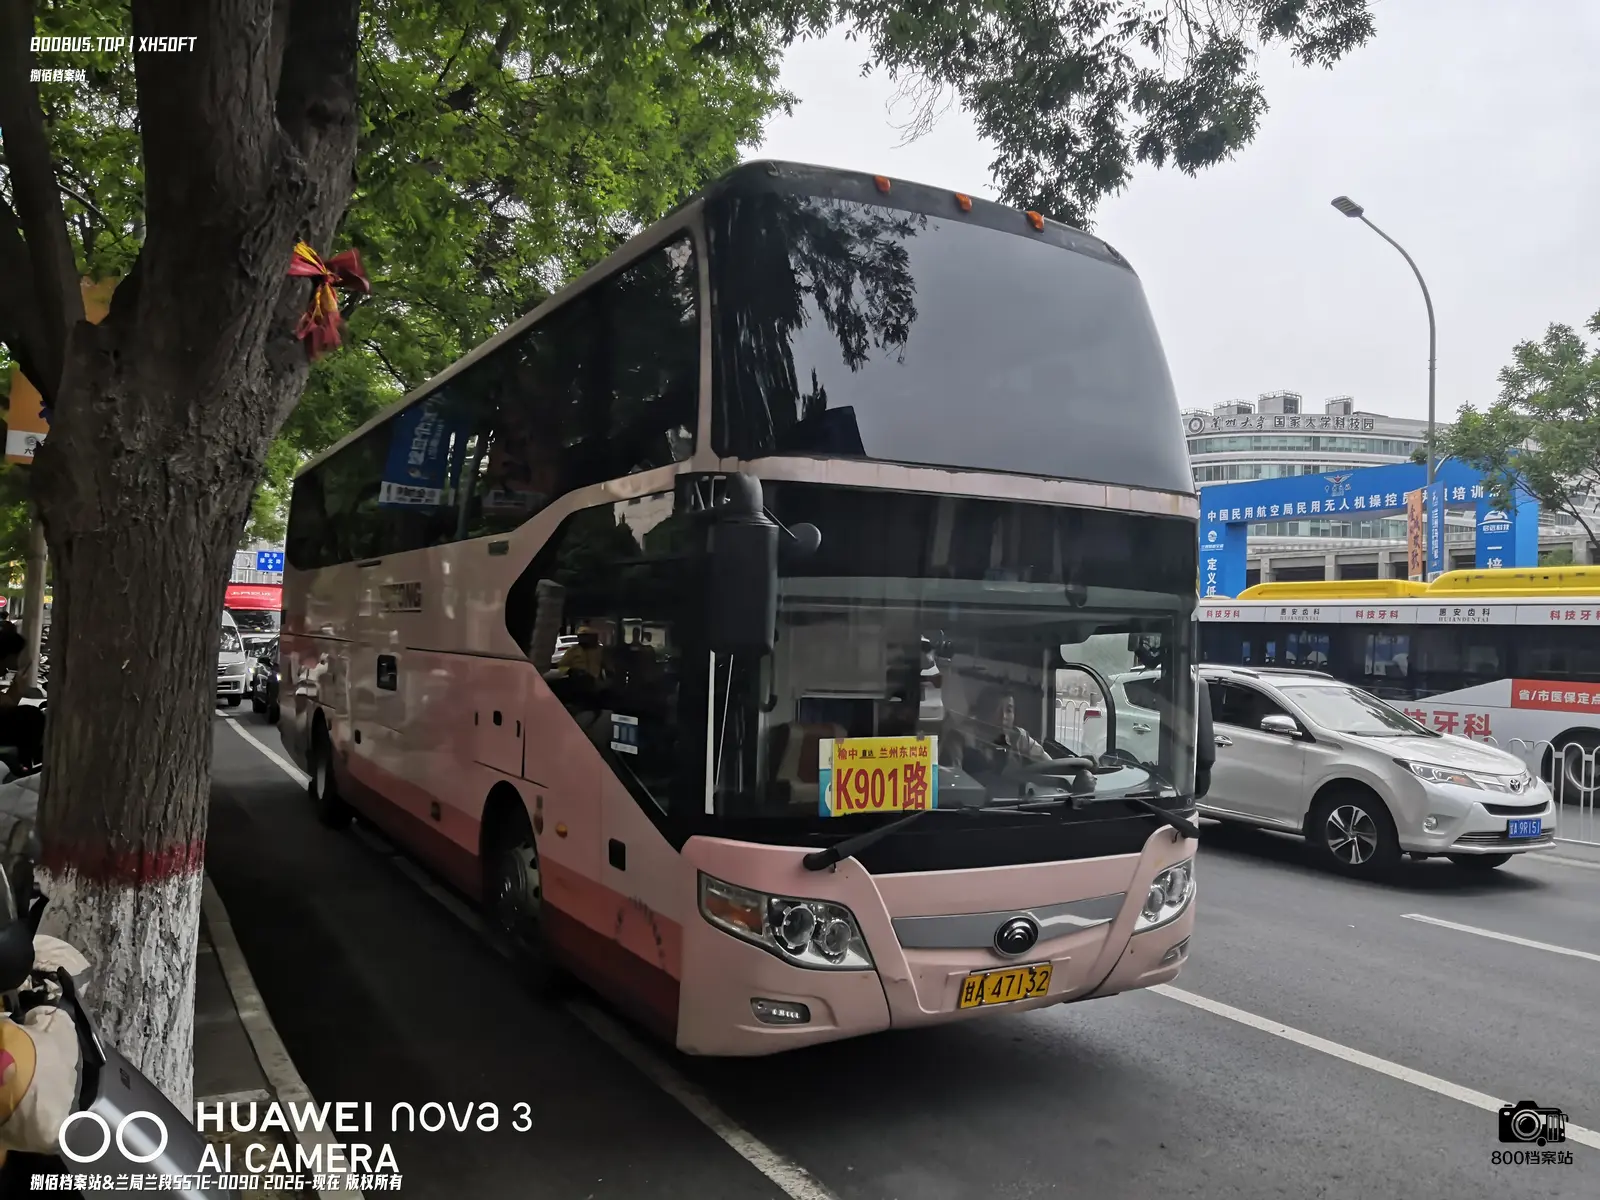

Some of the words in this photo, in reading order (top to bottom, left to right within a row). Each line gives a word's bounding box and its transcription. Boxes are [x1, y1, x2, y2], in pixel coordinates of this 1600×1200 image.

[1206, 610, 1240, 618] 科技牙科
[1355, 610, 1399, 619] 科技牙科
[836, 761, 928, 810] K901路
